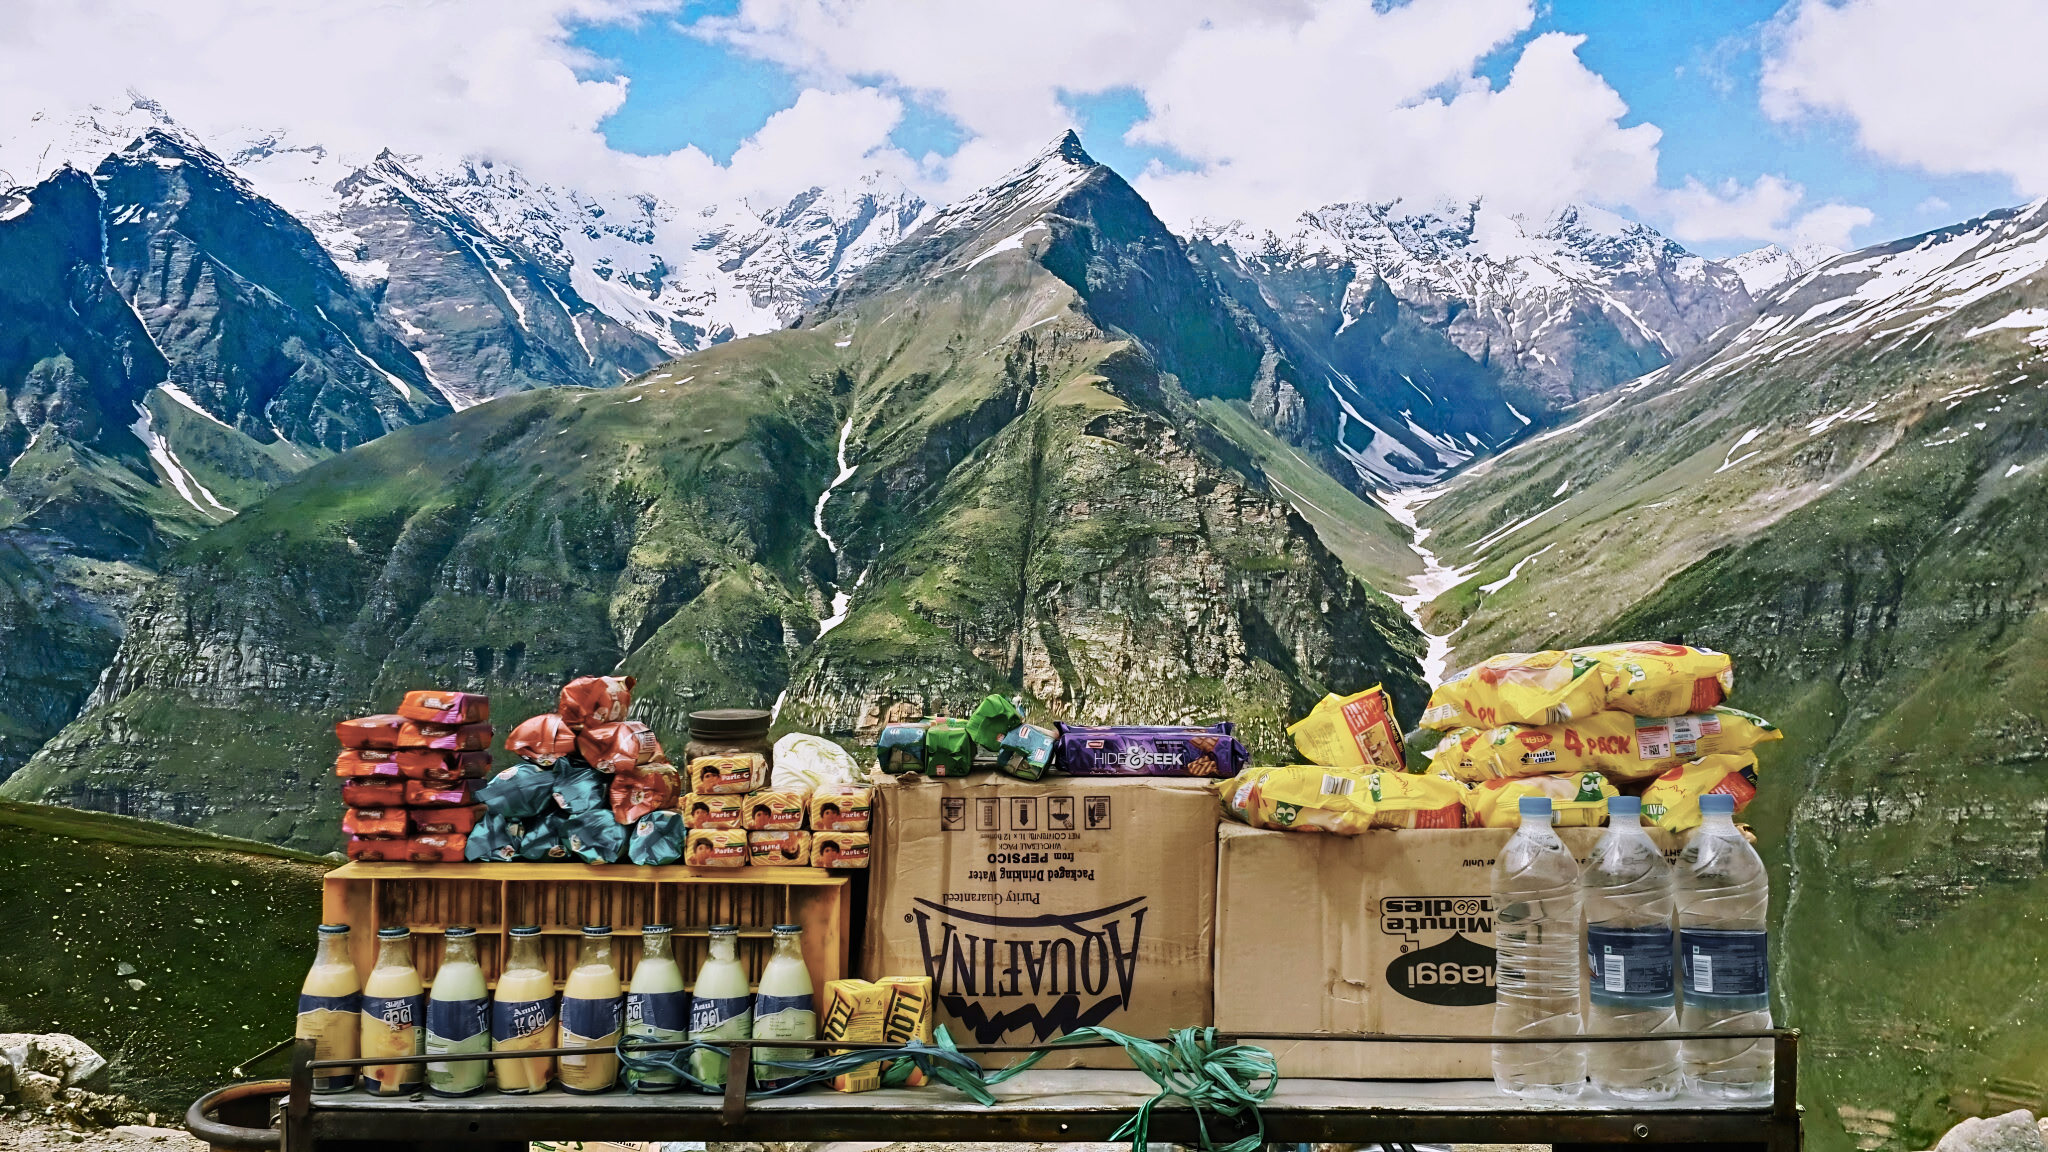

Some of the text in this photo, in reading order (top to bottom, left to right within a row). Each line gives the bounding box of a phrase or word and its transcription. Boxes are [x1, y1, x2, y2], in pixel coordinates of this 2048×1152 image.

[1564, 728, 1585, 757] 4
[1586, 735, 1631, 755] PACK
[721, 772, 750, 781] Parle-G
[714, 847, 743, 855] Parle-G
[998, 842, 1061, 850] WHOLESALE PACK
[987, 852, 1074, 863] from PEPSICO
[968, 866, 1095, 882] Packaged Drinking Water
[942, 890, 1040, 906] Purity Guaranteed
[912, 906, 1148, 1012] AQUAFINA
[513, 1002, 540, 1017] Amul
[693, 1000, 714, 1011] Amul
[692, 1008, 720, 1032] KOOL
[887, 990, 922, 1044] OOTI
